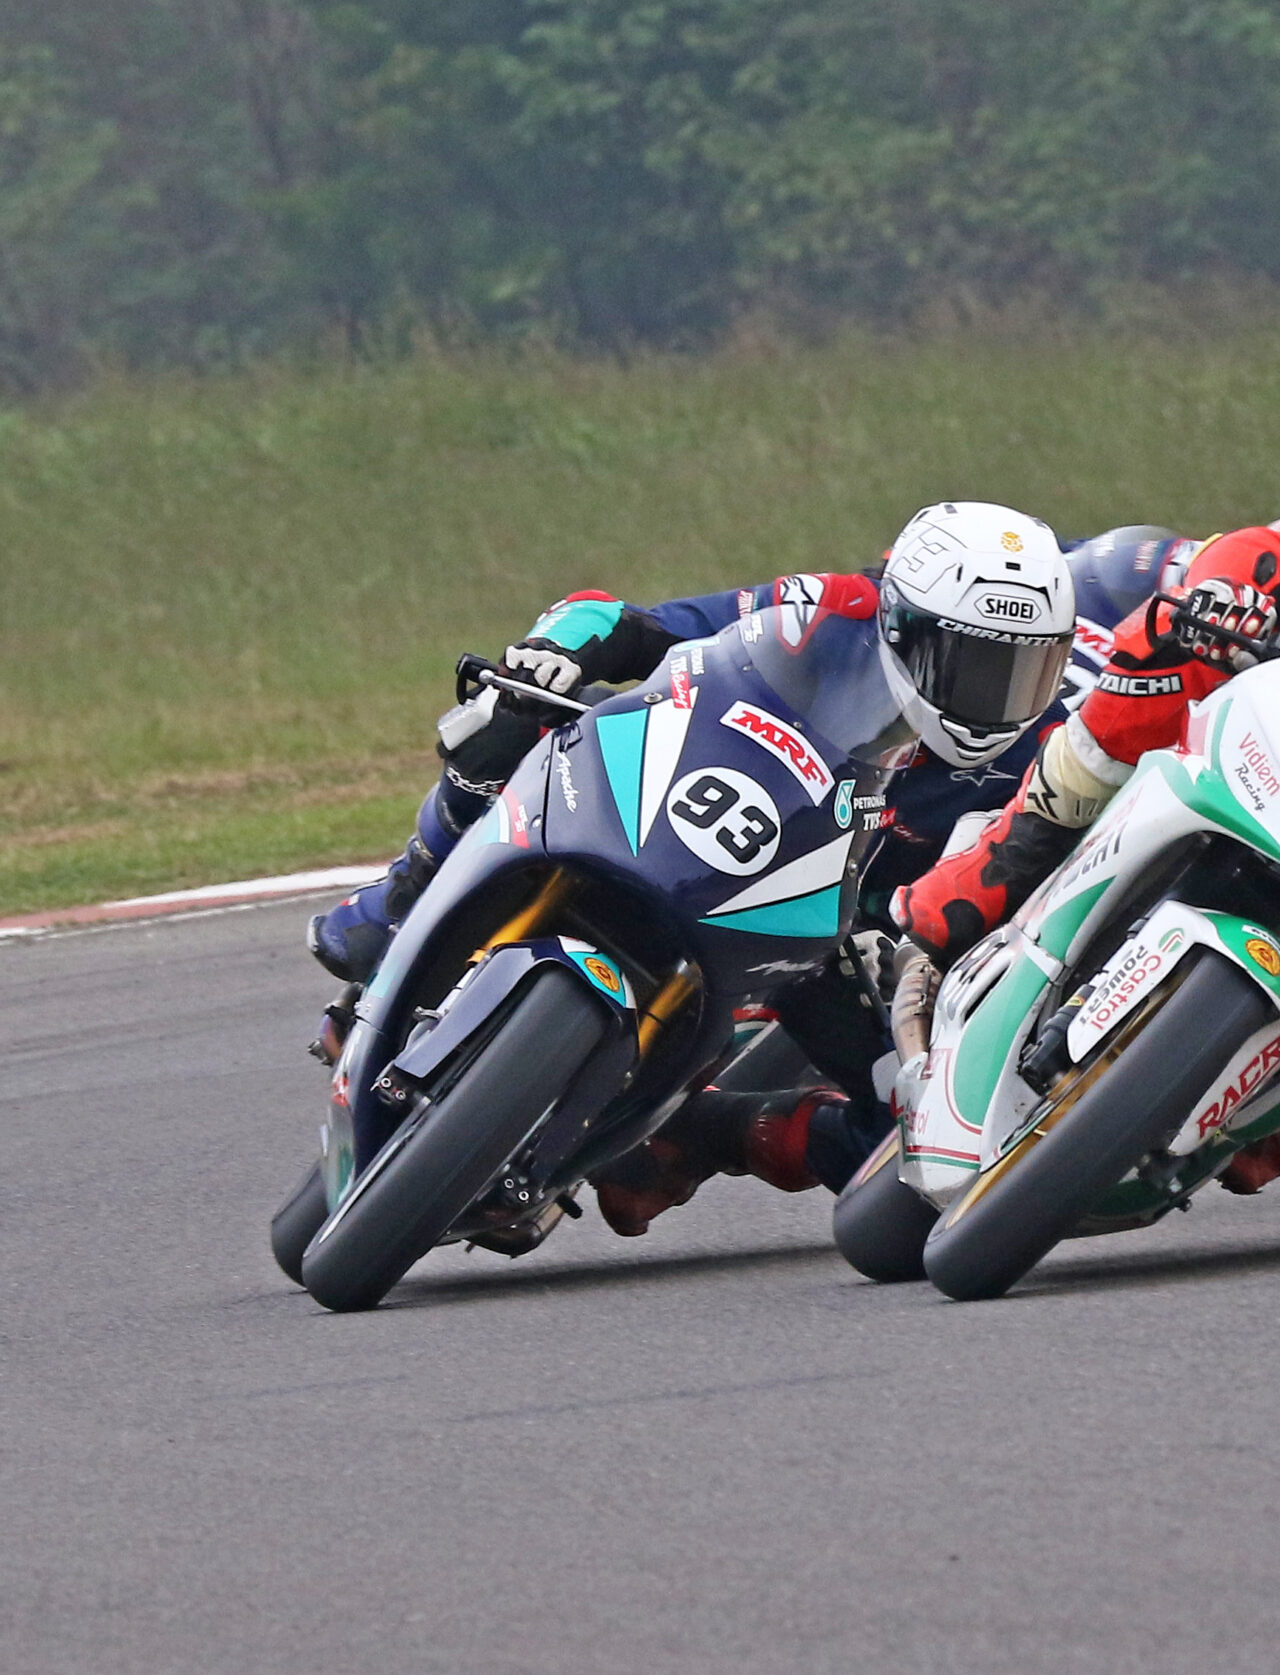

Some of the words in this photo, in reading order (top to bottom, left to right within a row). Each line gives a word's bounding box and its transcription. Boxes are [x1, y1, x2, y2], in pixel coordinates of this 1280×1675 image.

[937, 618, 1060, 647] CHIRANTH
[985, 598, 1034, 619] SHOEI
[731, 710, 828, 787] MRF
[1239, 732, 1280, 797] Vidiem
[556, 750, 580, 813] Apache
[853, 794, 886, 810] PETRONAS
[1235, 763, 1266, 812] Racing
[671, 775, 778, 864] 93
[863, 811, 881, 830] TVS
[1090, 953, 1162, 1031] Castrol
